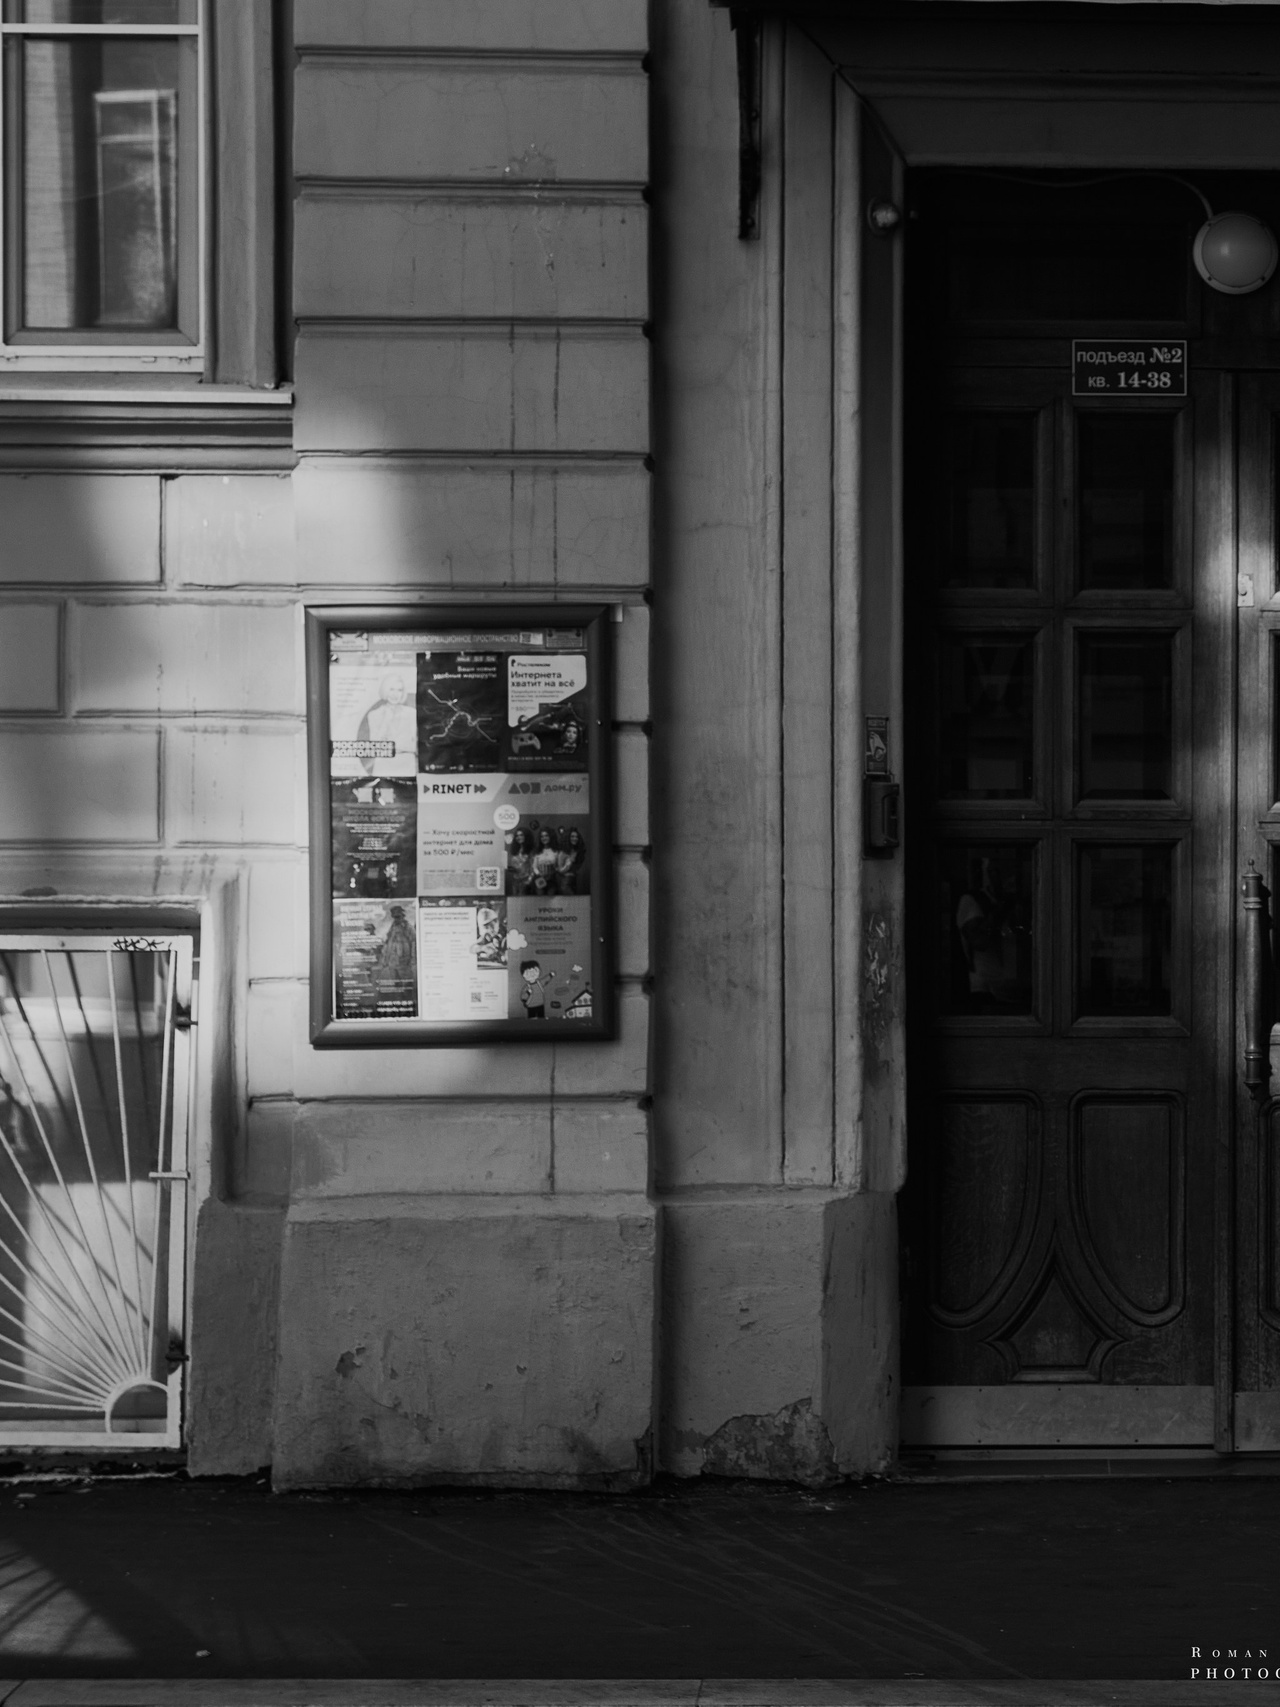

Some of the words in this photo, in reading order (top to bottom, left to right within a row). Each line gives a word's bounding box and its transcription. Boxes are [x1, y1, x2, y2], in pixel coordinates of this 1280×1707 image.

[1076, 351, 1146, 366] подъезд
[1149, 346, 1183, 364] №2
[1087, 376, 1111, 388] кв.
[1117, 371, 1172, 389] 14-38
[414, 635, 471, 643] ИНФОРМАЦИОННОЕ
[472, 634, 519, 643] ПРОСТРАНСТВО
[511, 671, 562, 680] Интернета
[511, 680, 542, 688] хватит
[558, 679, 576, 688] всё
[524, 915, 578, 923] АНГЛИЙСКОГО
